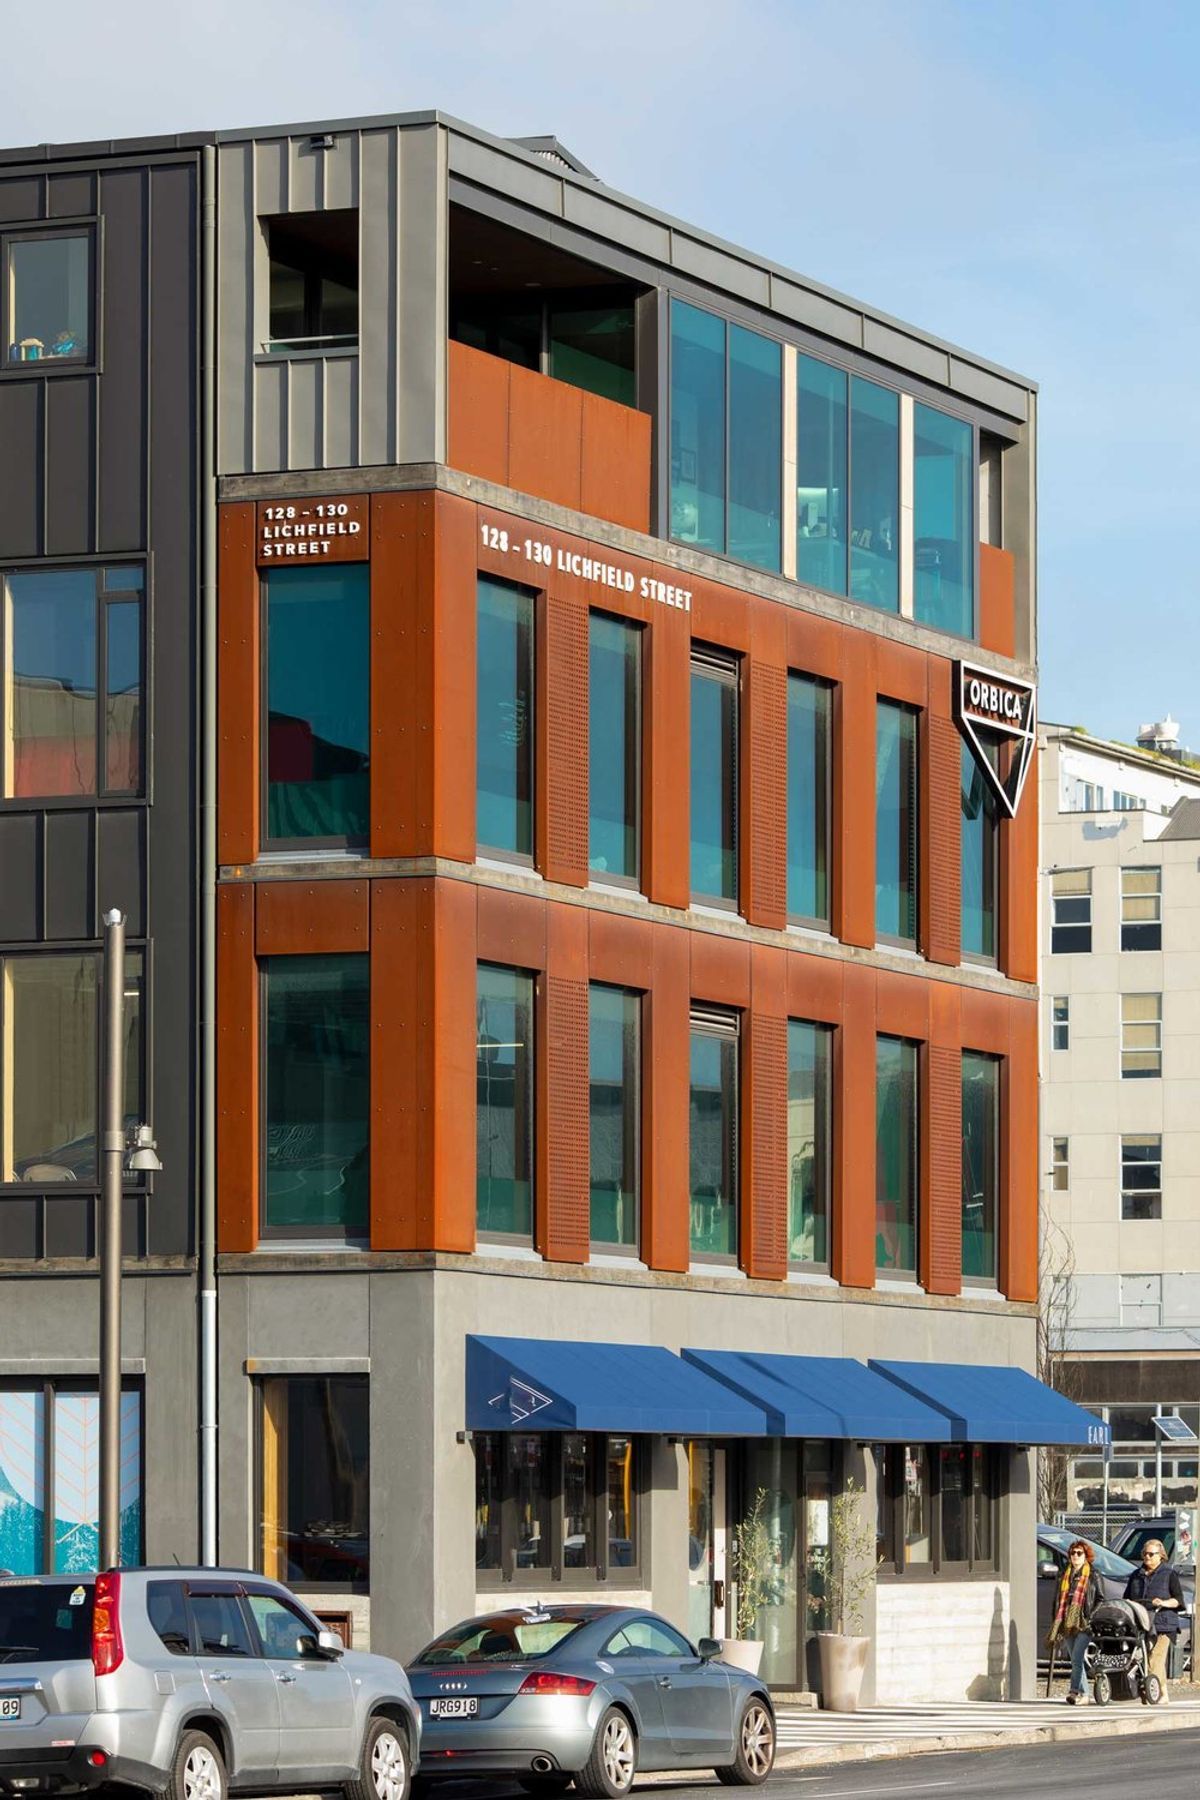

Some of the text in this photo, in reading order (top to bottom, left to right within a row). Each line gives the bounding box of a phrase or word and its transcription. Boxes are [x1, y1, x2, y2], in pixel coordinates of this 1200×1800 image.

[265, 506, 296, 519] 128
[316, 504, 348, 516] 130
[263, 521, 360, 538] LICHFIELD
[263, 541, 331, 556] STREET
[481, 524, 508, 552] 128
[524, 539, 552, 566] 130
[557, 549, 635, 592] LICHFIELD
[640, 576, 692, 611] STREET
[970, 679, 1021, 719] ORBICA
[1088, 1426, 1109, 1444] EARL
[432, 1699, 477, 1713] JRG918
